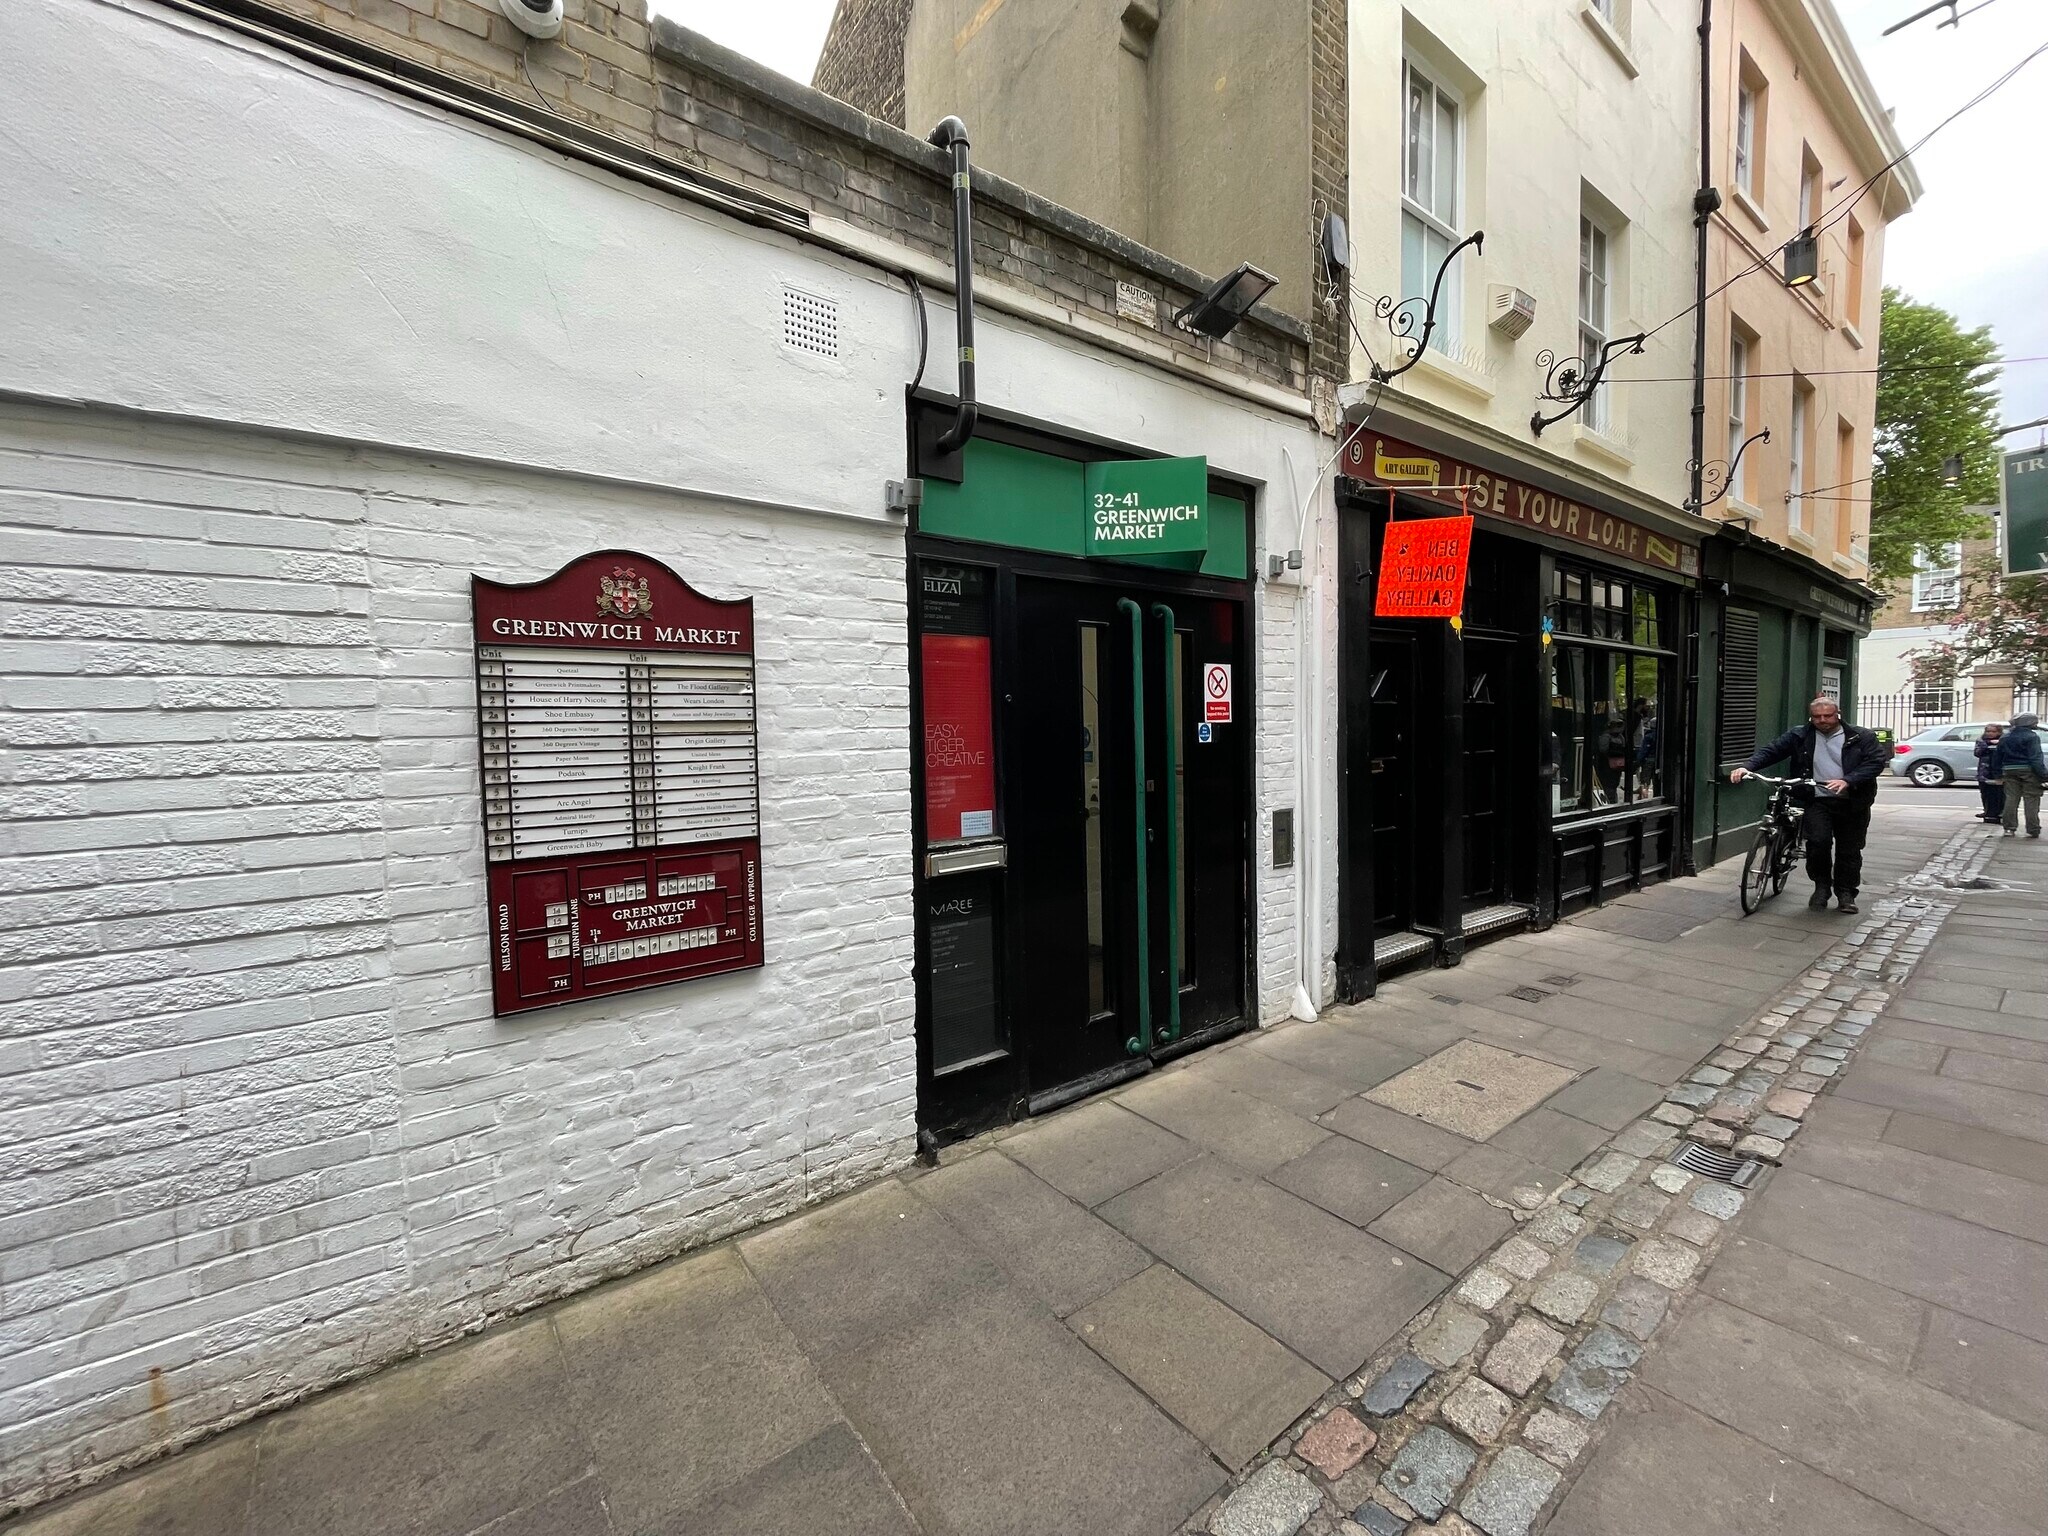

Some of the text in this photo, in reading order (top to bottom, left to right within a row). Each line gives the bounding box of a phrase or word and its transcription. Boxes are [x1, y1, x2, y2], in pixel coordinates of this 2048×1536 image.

[1120, 283, 1153, 303] CAUTION
[1352, 443, 1360, 461] 9
[1384, 463, 1430, 476] ART GALLERY
[2011, 457, 2048, 475] TR
[1093, 492, 1139, 508] 32-41
[1455, 465, 1640, 553] USE YOUR LOAF
[1093, 504, 1198, 525] GREENWICH
[1094, 523, 1165, 541] MARKET
[923, 580, 958, 595] ELIZA
[492, 618, 740, 645] GREENWICH MARKET
[481, 648, 503, 658] Unit
[629, 653, 647, 662] Unit
[634, 668, 644, 676] 7a
[637, 683, 642, 691] 8
[708, 684, 730, 692] Gallery
[489, 696, 496, 704] 2
[563, 696, 583, 705] Harry
[637, 697, 643, 705] 9
[488, 711, 499, 719] 2a
[564, 711, 594, 719] Embassy
[636, 711, 645, 719] 9a
[491, 727, 497, 735] 3
[637, 725, 646, 733] 10
[925, 723, 960, 739] EASY
[635, 739, 648, 747] 10a
[684, 737, 727, 746] Origin Gallery
[926, 737, 965, 753] TIGER
[489, 742, 500, 751] 3a
[637, 753, 647, 761] 11
[926, 751, 986, 768] CREATIVE
[492, 758, 498, 766] 4
[636, 766, 649, 775] 11a
[687, 764, 709, 772] Knight
[491, 773, 502, 781] 4a
[638, 780, 648, 788] 12
[570, 798, 592, 807] Angel
[639, 809, 650, 817] 15
[639, 822, 650, 831] 16
[562, 828, 588, 836] Turnips
[694, 831, 722, 839] Corkville
[639, 836, 650, 844] 17
[546, 843, 585, 851] Greenwich
[497, 849, 503, 857] 7
[588, 892, 601, 901] PH
[747, 860, 757, 942] COLLEGE APPROACH
[612, 899, 697, 921] GREENWICH
[930, 899, 973, 916] MAREE
[553, 917, 562, 925] 15
[625, 913, 684, 932] MARKET
[570, 898, 580, 959] TURNPIN LANE
[725, 928, 737, 937] PH
[499, 903, 512, 972] NELSON ROAD
[554, 937, 563, 945] 16
[554, 948, 563, 956] 17
[621, 947, 630, 955] 10
[554, 979, 568, 988] PH
